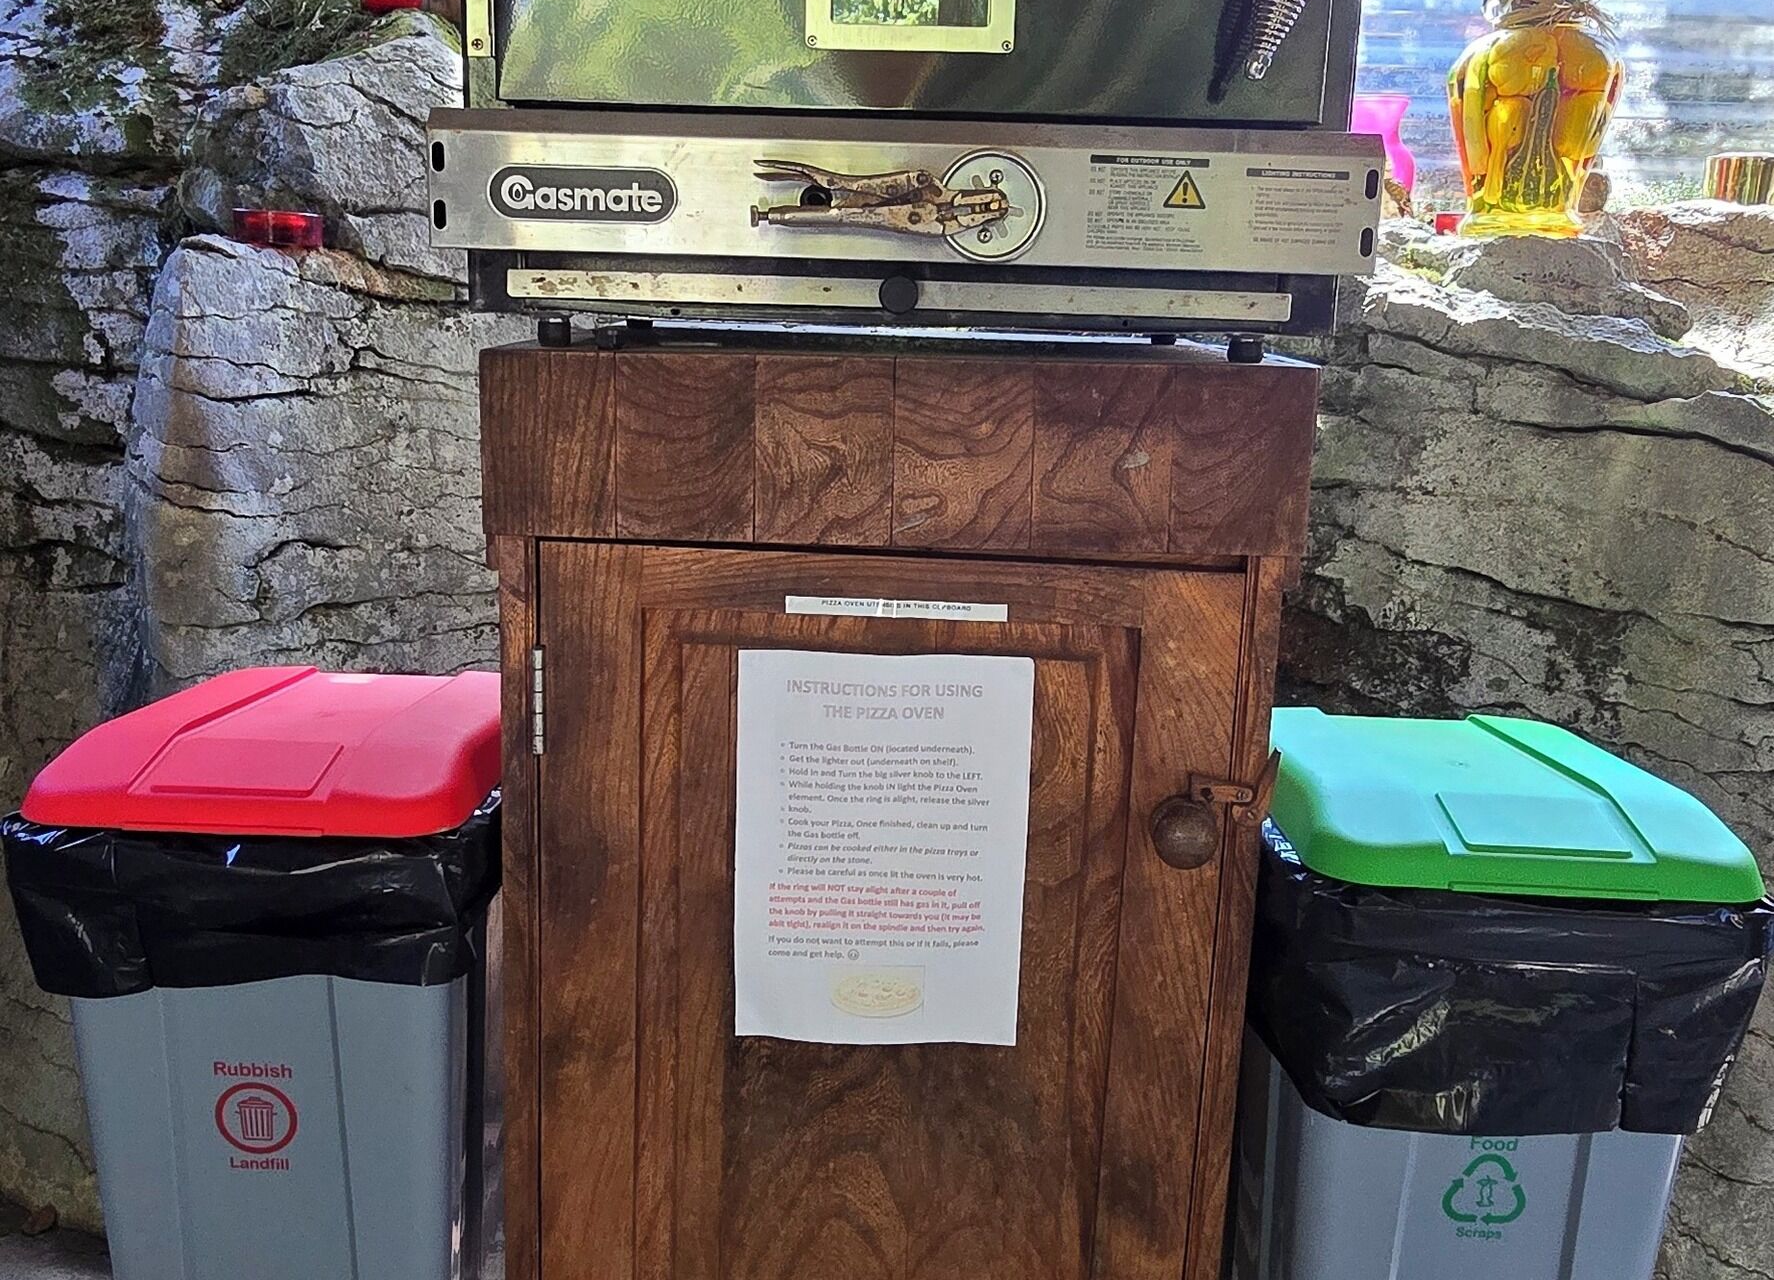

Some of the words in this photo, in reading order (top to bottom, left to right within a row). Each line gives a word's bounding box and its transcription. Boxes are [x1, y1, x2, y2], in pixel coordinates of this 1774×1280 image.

[501, 175, 663, 212] Gasmate
[787, 680, 897, 697] INSTRUCTIONS
[901, 682, 930, 697] FOR
[935, 684, 983, 698] USING
[823, 705, 852, 719] THE
[856, 706, 898, 720] PIZZA
[902, 706, 944, 720] OVEN
[789, 742, 808, 750] Turn
[886, 745, 919, 753] (located
[921, 745, 974, 755] underneath).
[822, 757, 848, 765] lighter
[867, 758, 918, 766] (underneath
[838, 770, 856, 778] Turn
[875, 771, 887, 779] big
[864, 783, 884, 791] knob
[897, 783, 916, 791] light
[934, 784, 954, 792] Pizza
[956, 785, 977, 793] Oven
[866, 796, 882, 804] ring
[968, 798, 989, 806] silver
[789, 805, 811, 813] knob.
[788, 818, 808, 826] Cook
[917, 821, 938, 829] clean
[970, 824, 988, 832] turn
[948, 849, 968, 857] trays
[787, 867, 813, 875] Please
[947, 874, 964, 882] very
[966, 874, 983, 882] hot.
[828, 884, 845, 892] NOT
[847, 885, 864, 894] stay
[891, 887, 910, 895] after
[919, 889, 946, 897] couple
[948, 889, 956, 897] of
[841, 897, 855, 905] Gas
[769, 907, 782, 915] the
[785, 907, 805, 915] knob
[807, 908, 817, 916] by
[863, 922, 876, 930] the
[855, 939, 887, 947] attempt
[889, 939, 904, 947] this
[213, 1061, 292, 1078] Rubbish
[230, 1156, 289, 1170] Landfill
[1455, 1227, 1501, 1240] Scraps
